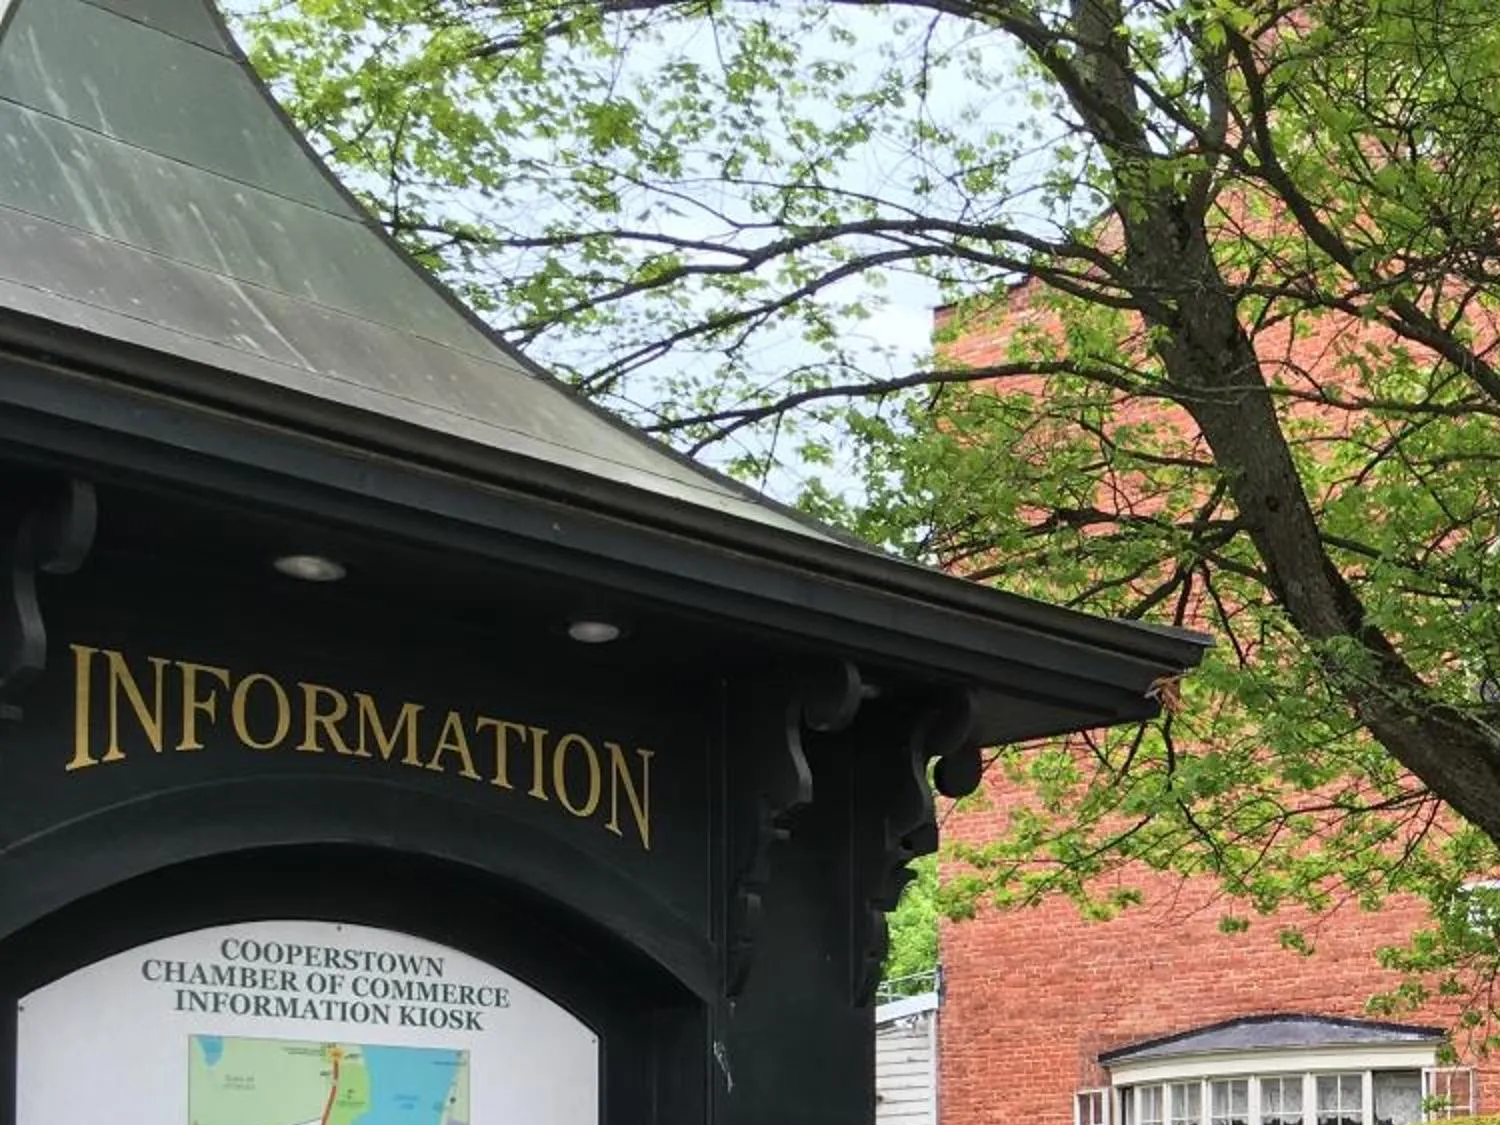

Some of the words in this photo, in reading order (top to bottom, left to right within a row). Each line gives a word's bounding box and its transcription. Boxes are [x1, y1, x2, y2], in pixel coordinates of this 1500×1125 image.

[65, 643, 655, 851] INFORMATION
[220, 938, 445, 977] COOPERSTOWN
[141, 959, 300, 992] CHAMBER
[306, 971, 345, 995] OF
[352, 976, 511, 1008] COMMERCE
[174, 989, 390, 1025] INFORMATION
[400, 1005, 485, 1031] KIOSK
